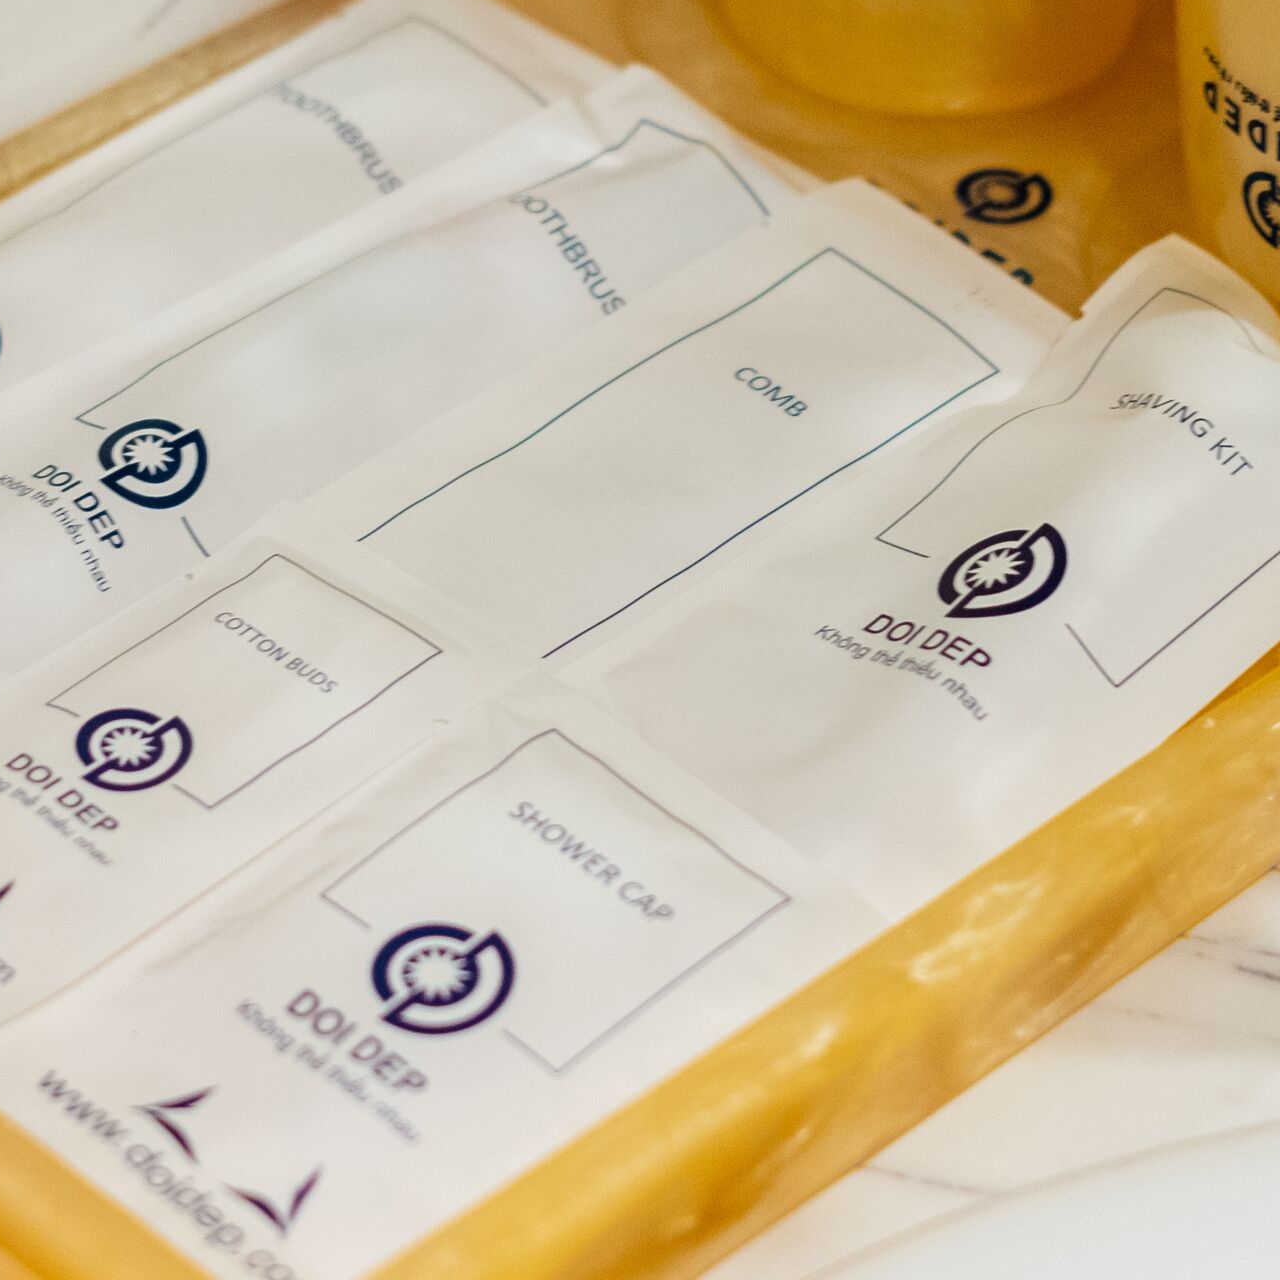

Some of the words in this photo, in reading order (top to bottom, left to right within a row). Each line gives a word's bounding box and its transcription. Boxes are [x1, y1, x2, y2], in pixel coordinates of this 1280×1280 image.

[734, 367, 809, 417] COMB
[1110, 392, 1215, 438] SHAVING
[1208, 437, 1254, 476] KIT
[30, 464, 83, 493] DOI
[72, 491, 125, 549] DEP
[214, 611, 291, 662] COTTON
[284, 656, 339, 693] BUDS
[813, 624, 873, 660] Không
[940, 677, 990, 722] nhau
[862, 613, 927, 646] DOI
[918, 629, 993, 668] DEP
[5, 752, 63, 791] DOI
[56, 789, 119, 831] DEP
[508, 801, 622, 885] SHOWER
[618, 880, 675, 919] CAP
[286, 988, 358, 1046] DOI
[349, 1034, 428, 1091] DEP
[38, 1068, 296, 1280] www.doidep.co
